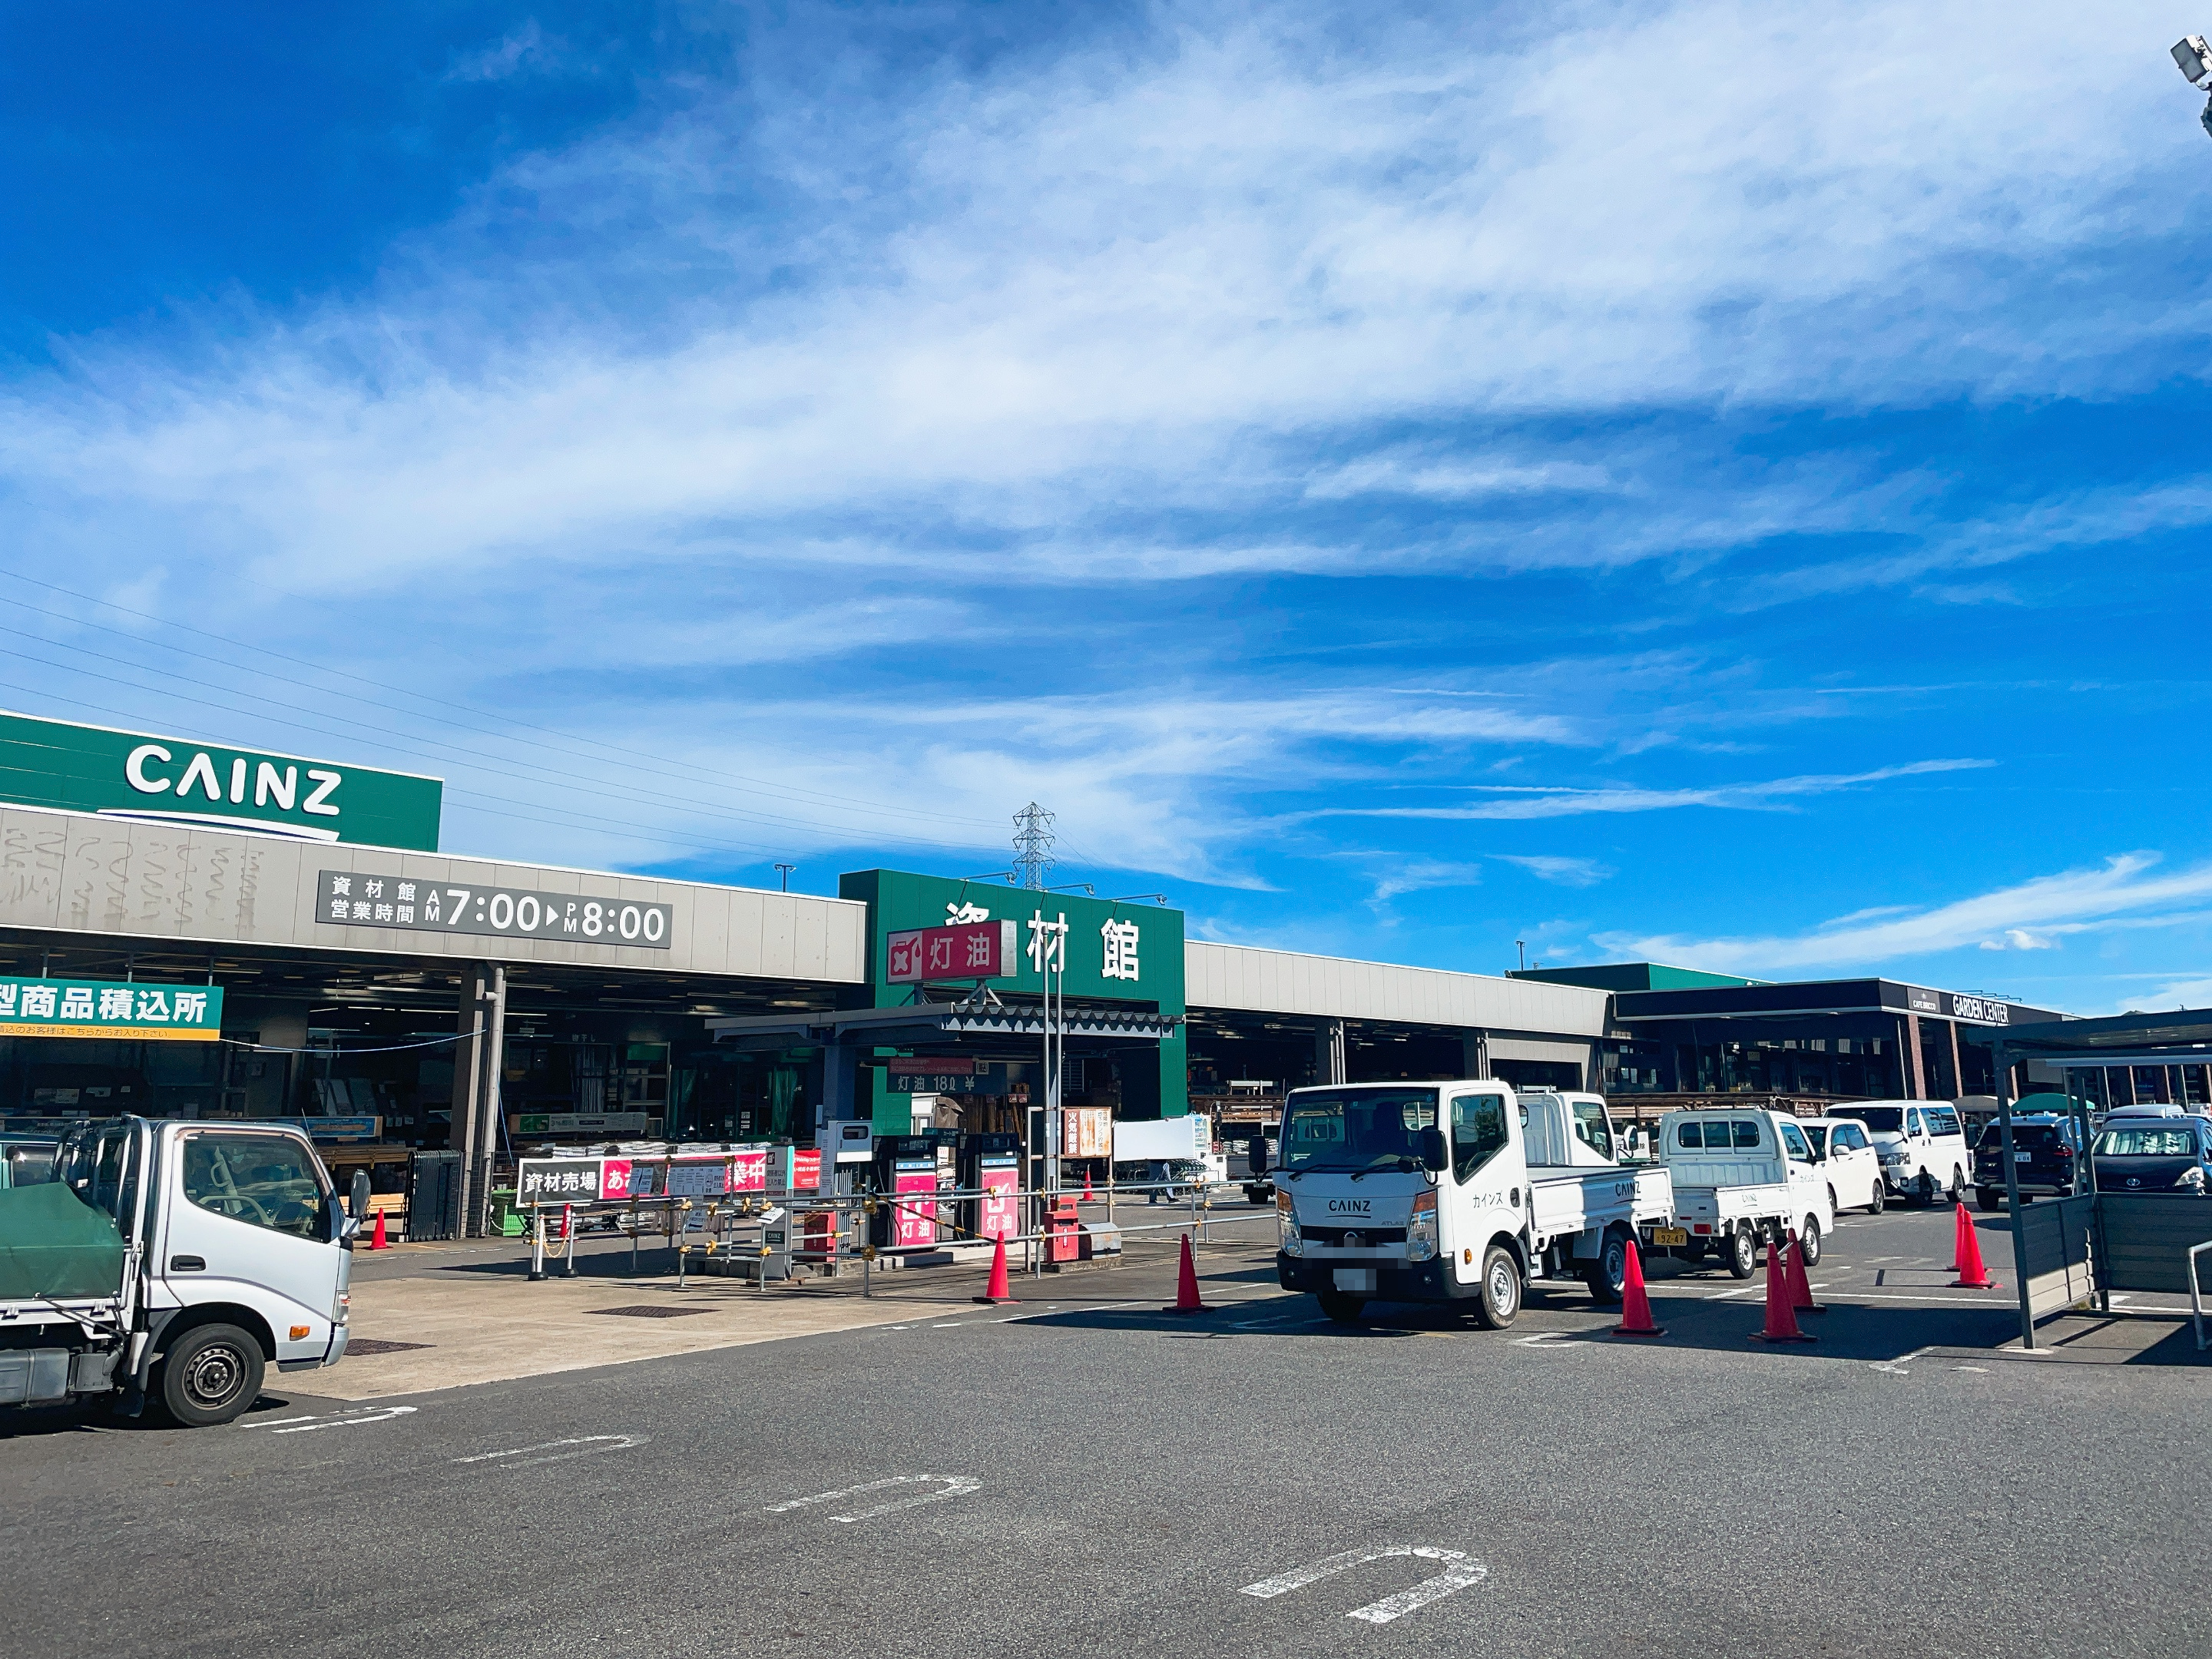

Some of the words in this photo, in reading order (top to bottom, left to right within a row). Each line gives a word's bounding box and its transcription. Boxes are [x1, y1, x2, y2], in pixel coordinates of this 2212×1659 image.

[124, 744, 342, 816] CAINZ
[332, 876, 416, 902] 資材館
[330, 899, 414, 923] 営業時間
[446, 889, 540, 932] 7:00
[581, 902, 664, 942] 8:00
[929, 932, 991, 971] 灯油
[1912, 999, 1922, 1008] CAFE
[1952, 995, 1984, 1020] GARDEN
[1984, 1001, 2008, 1023] CENTER
[898, 1075, 925, 1091] 灯油
[525, 1172, 597, 1192] 資材売場
[1615, 1181, 1641, 1197] CAINZ
[1329, 1200, 1371, 1211] CAINZ
[1473, 1190, 1503, 1208] カインズ
[902, 1221, 930, 1238] 灯油
[986, 1214, 1012, 1231] 灯油
[1661, 1234, 1684, 1243] 92-47
